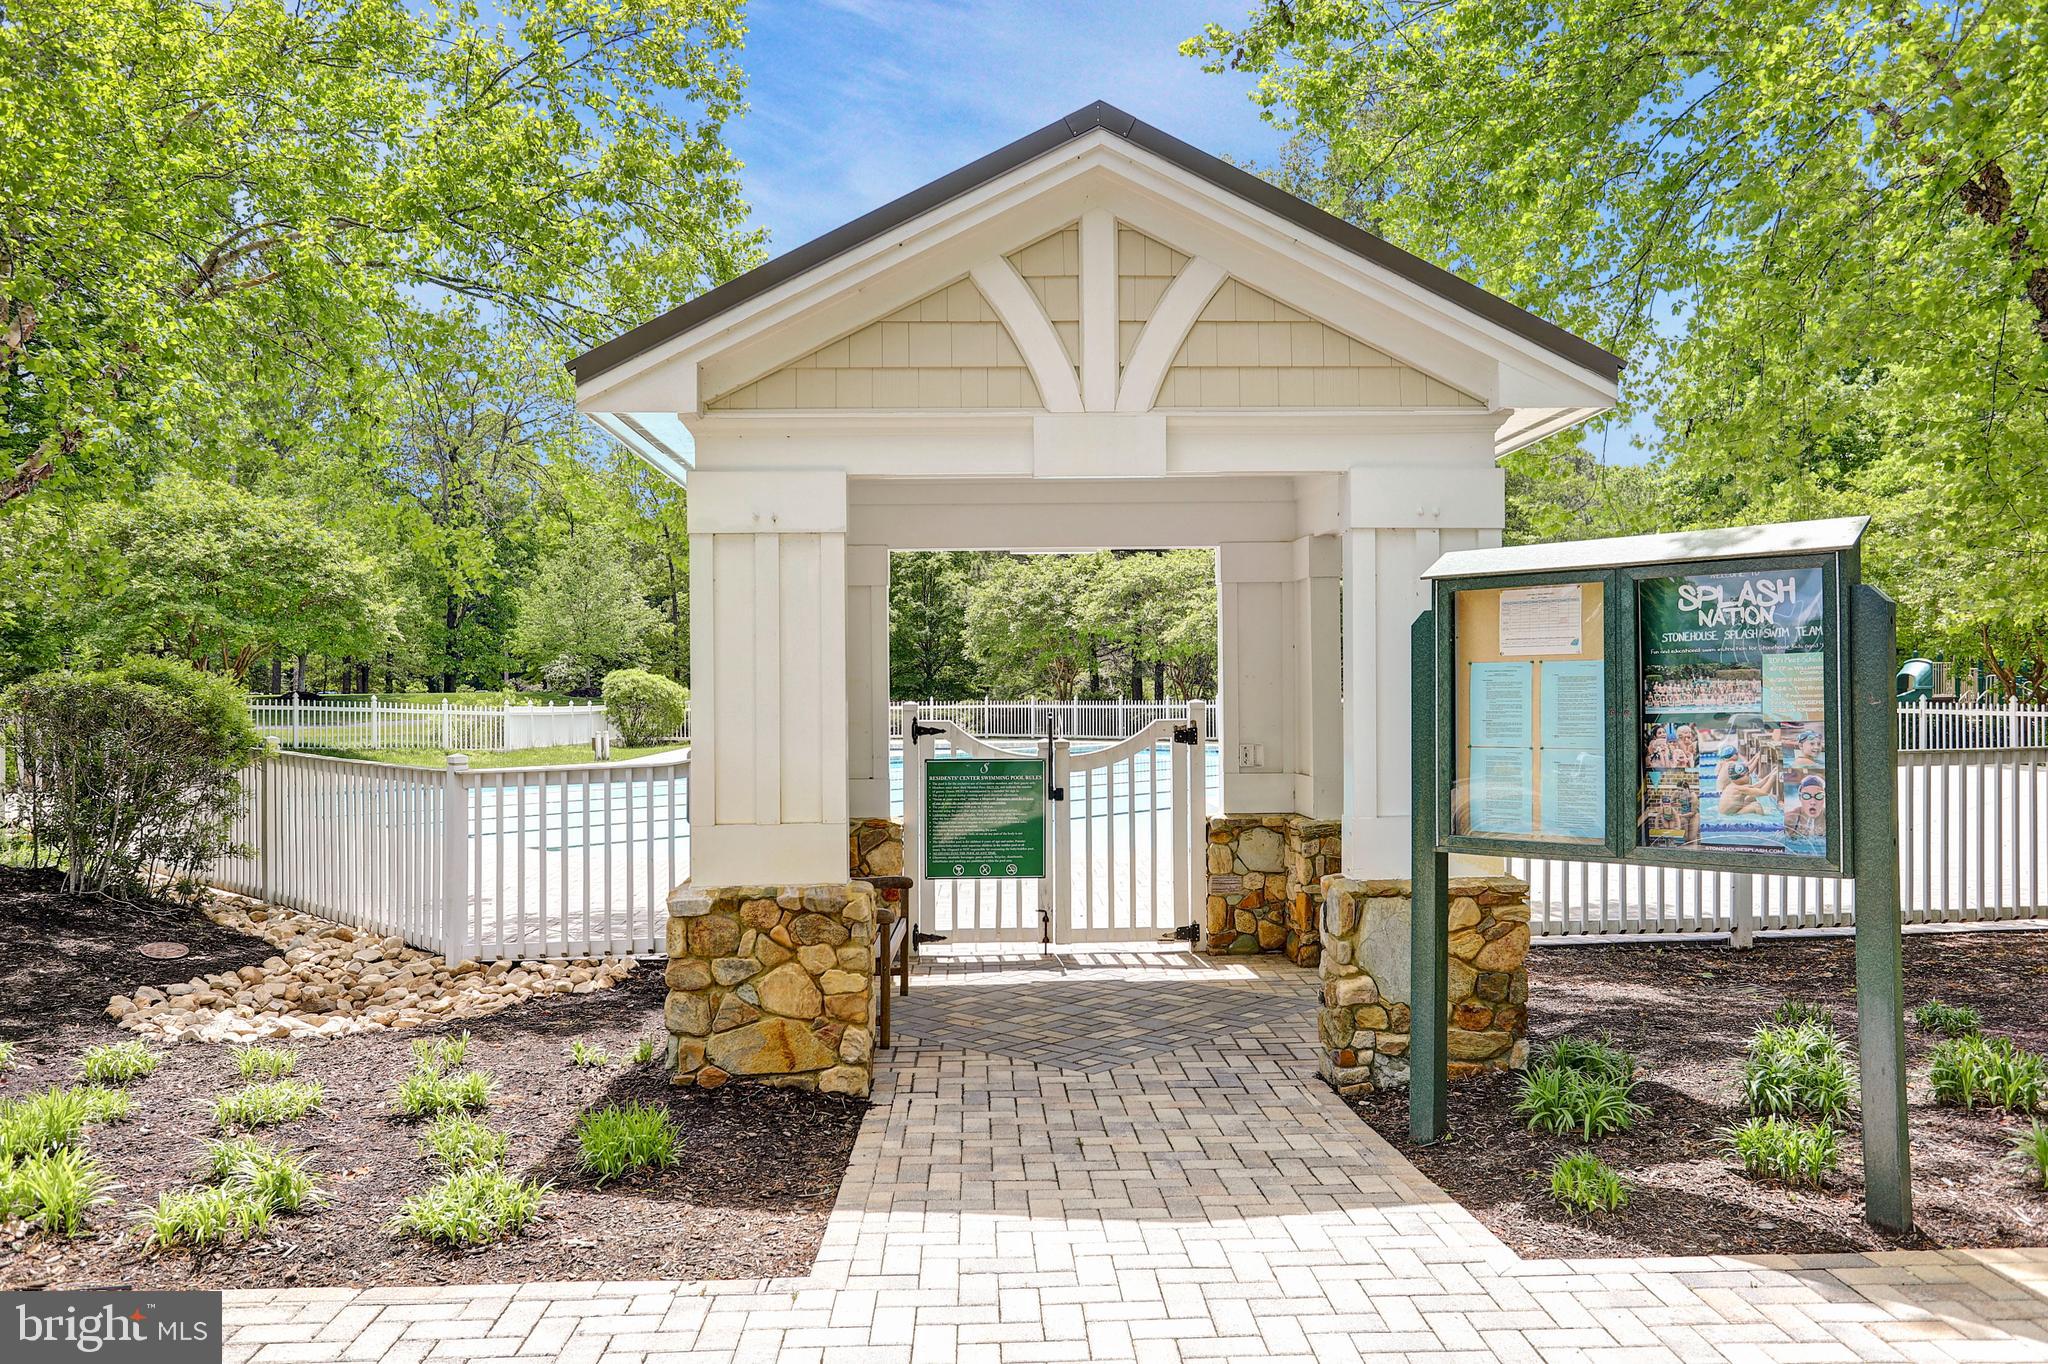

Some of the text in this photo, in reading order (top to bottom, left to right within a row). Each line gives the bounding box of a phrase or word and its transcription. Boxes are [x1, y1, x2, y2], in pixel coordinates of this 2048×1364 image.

[1678, 577, 1795, 612] SPLASH
[1661, 625, 1823, 642] STONEHOUSE SPLASH SWIM TEAM
